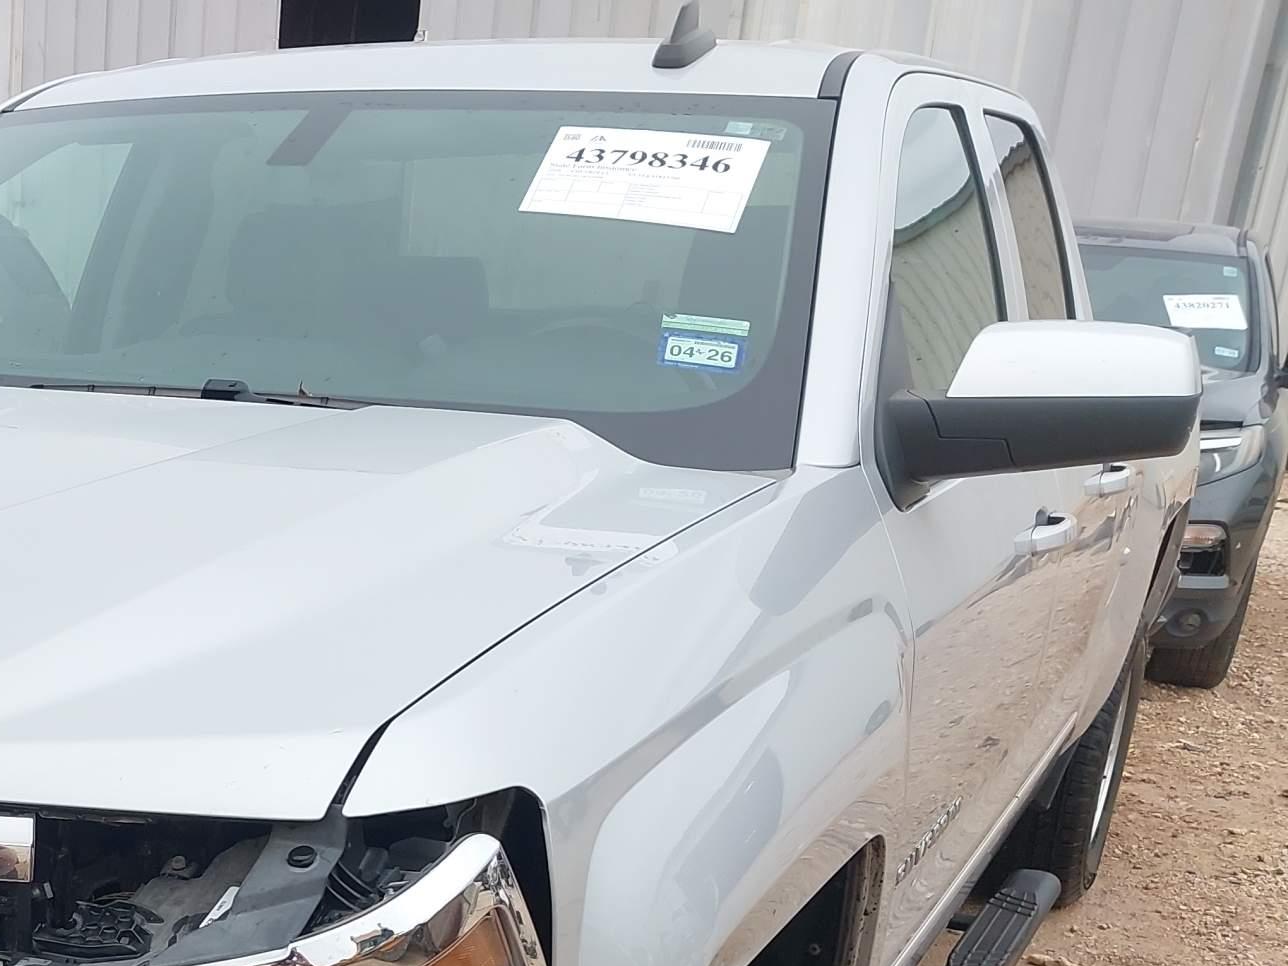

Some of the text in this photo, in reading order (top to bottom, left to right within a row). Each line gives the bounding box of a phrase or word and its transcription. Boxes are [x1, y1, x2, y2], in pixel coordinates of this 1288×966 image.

[565, 147, 732, 173] 43798346
[669, 344, 695, 358] 04
[705, 348, 734, 363] 26
